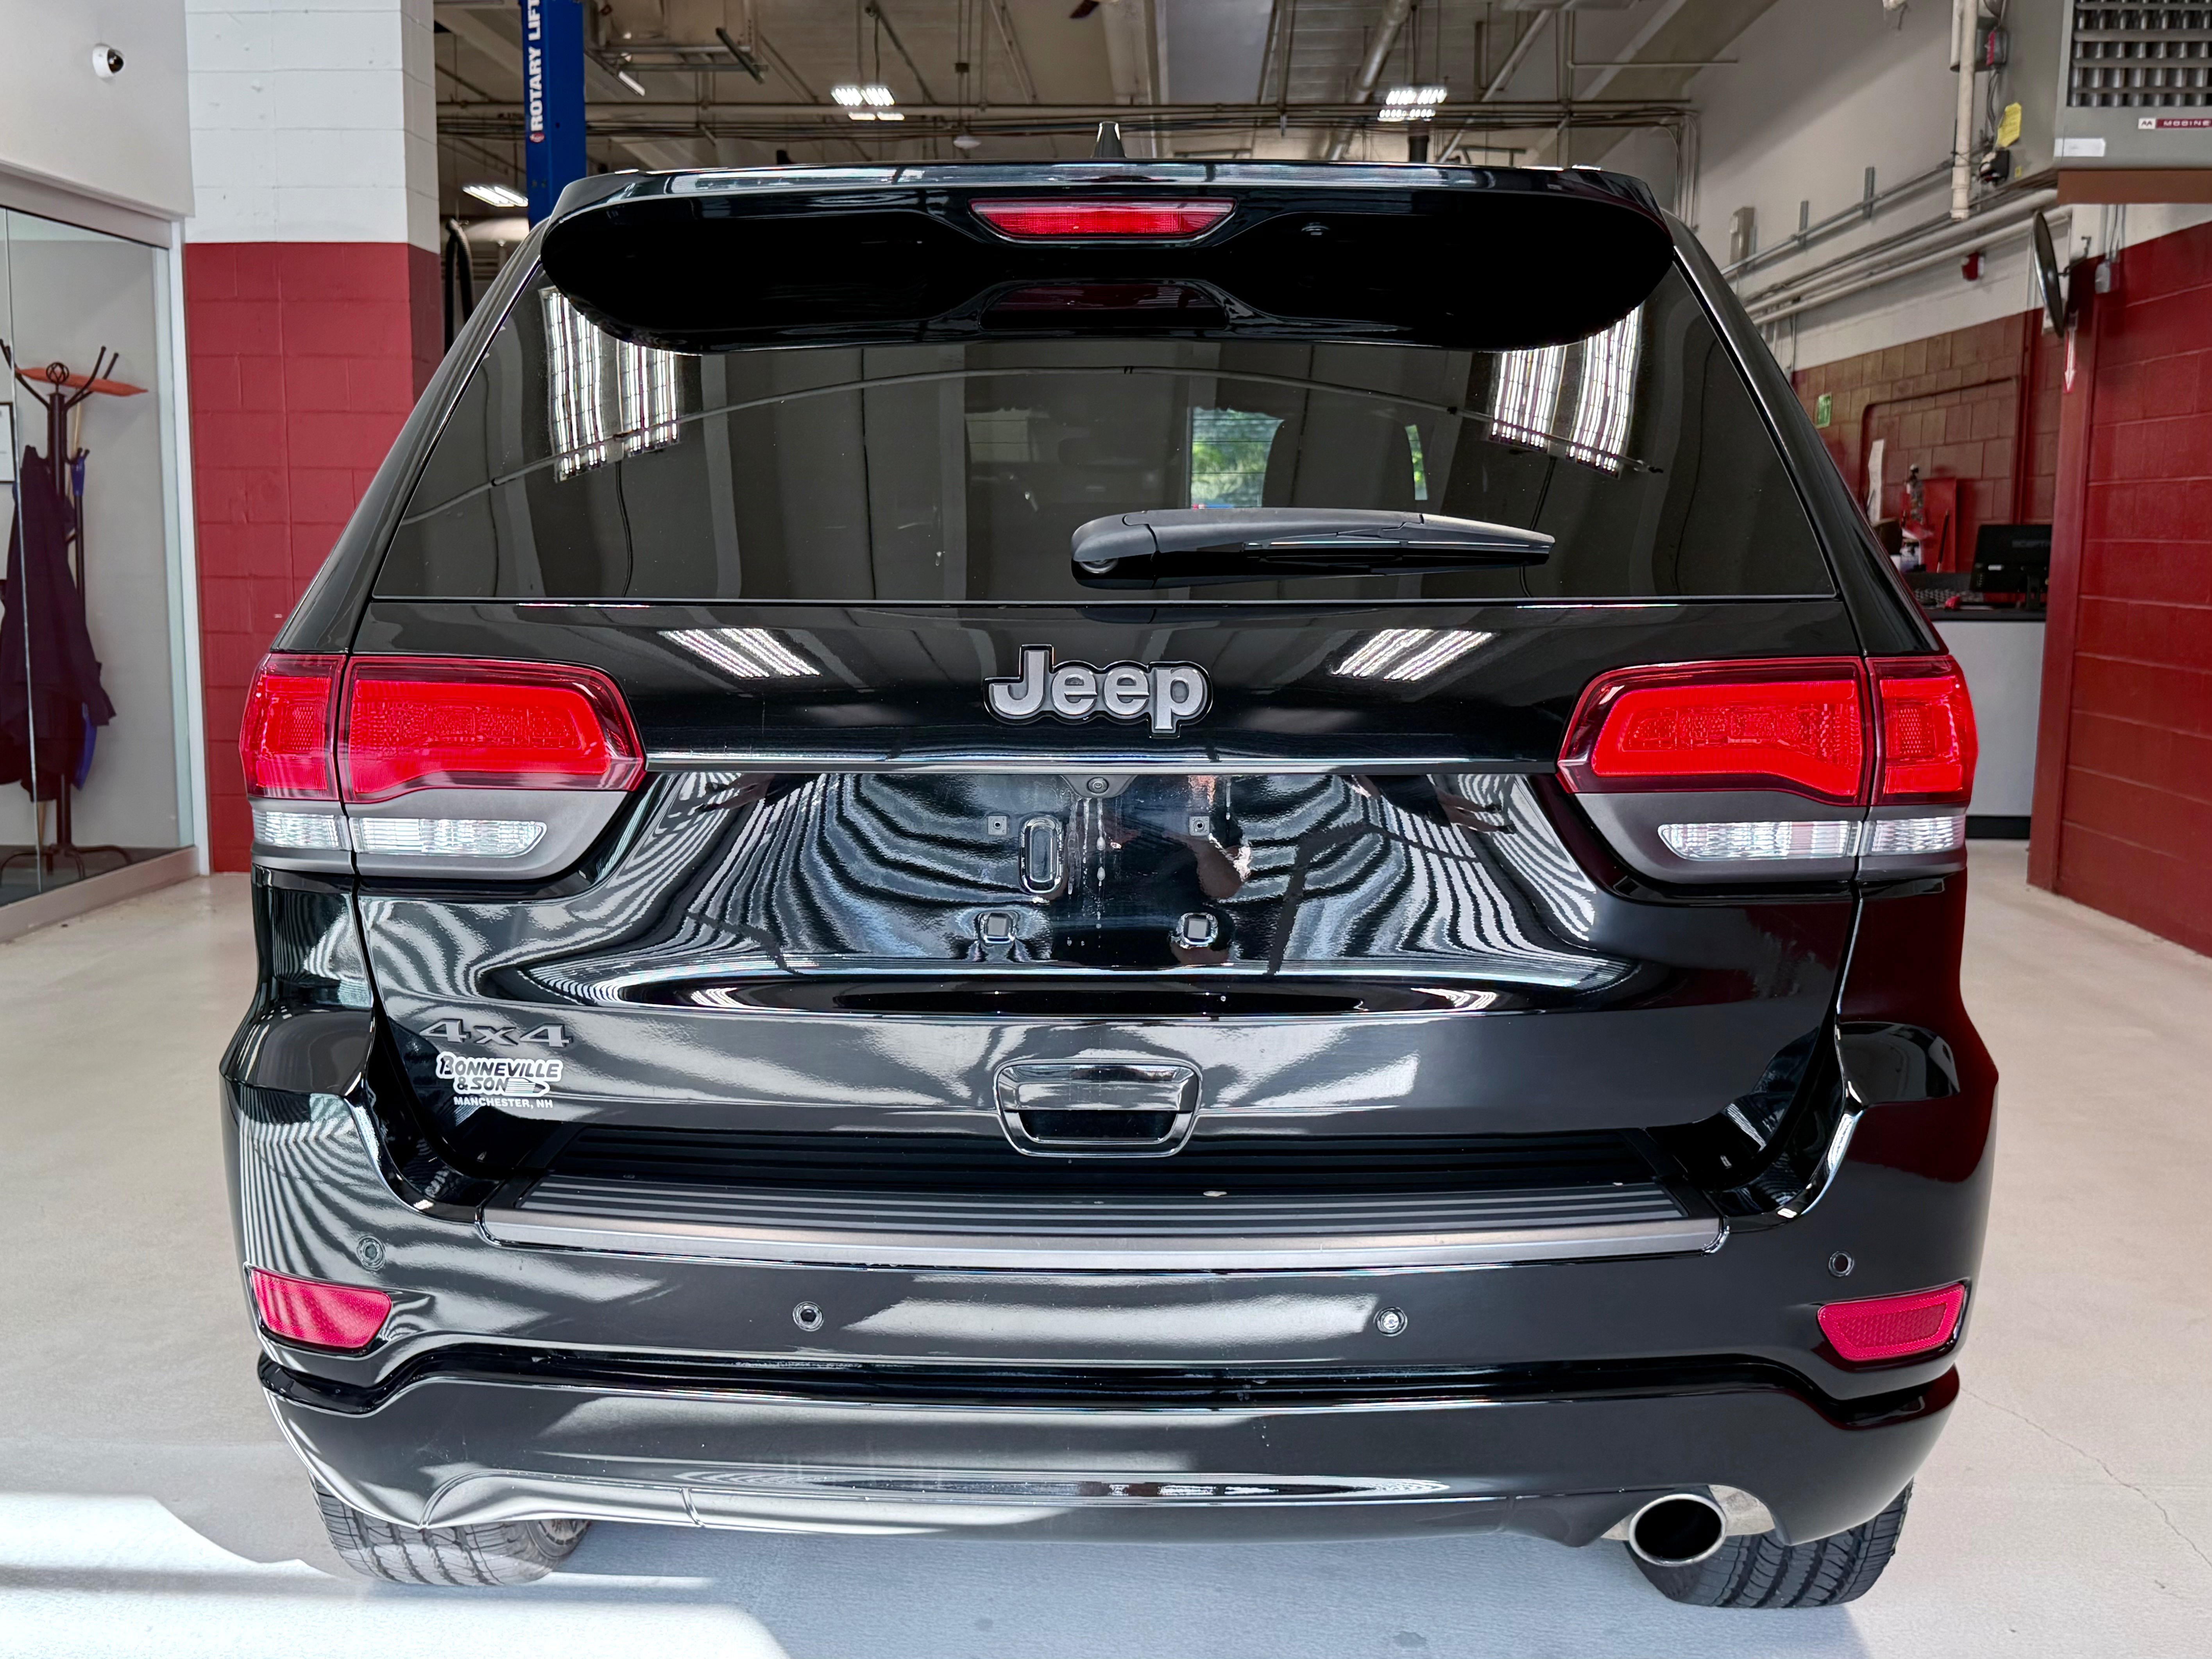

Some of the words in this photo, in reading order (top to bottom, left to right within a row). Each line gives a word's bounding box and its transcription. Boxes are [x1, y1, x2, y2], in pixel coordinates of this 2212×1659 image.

[528, 0, 541, 41] LIFT
[529, 47, 543, 131] ROTARY
[988, 648, 1208, 732] Jeep
[420, 1018, 574, 1048] 4x4
[439, 1055, 560, 1078] BONNEVILLE
[453, 1096, 534, 1109] MANCHESTER,
[536, 1098, 554, 1109] NH
